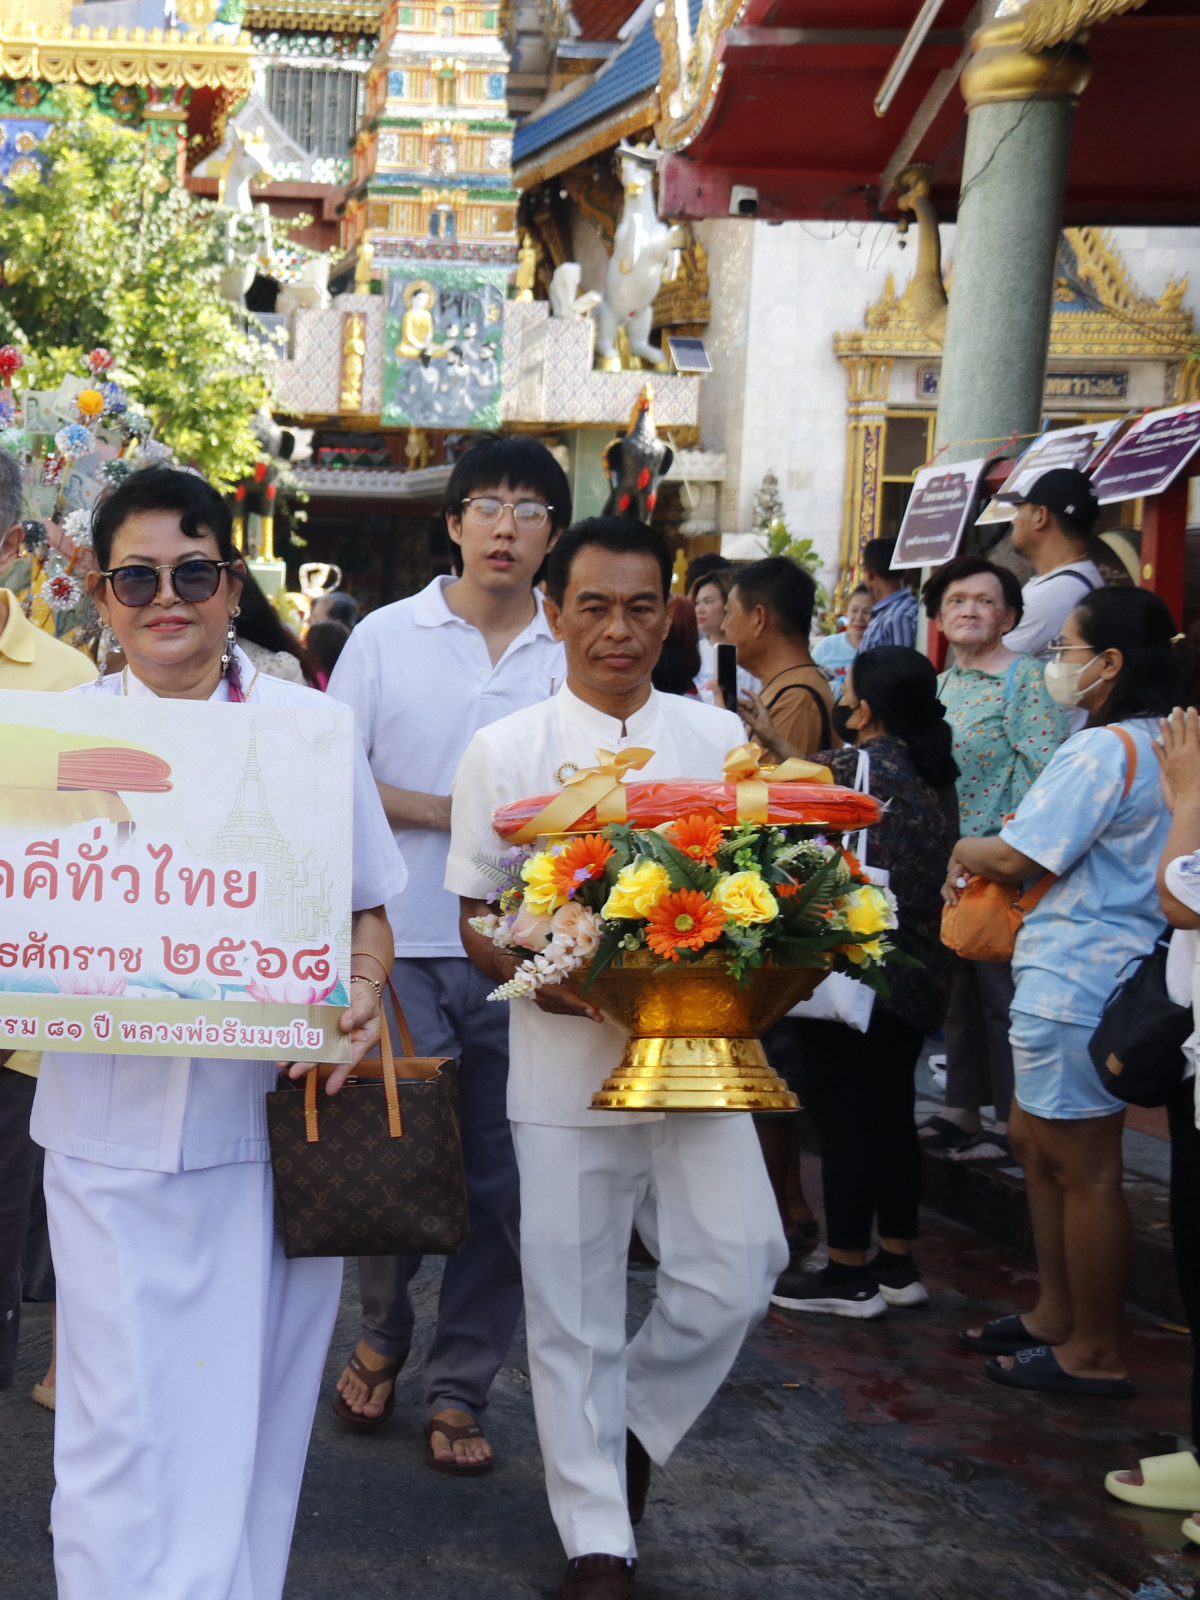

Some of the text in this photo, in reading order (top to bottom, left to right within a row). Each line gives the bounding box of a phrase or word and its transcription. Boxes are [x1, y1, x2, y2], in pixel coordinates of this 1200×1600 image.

[161, 935, 331, 982] ๒๕๖๘
[47, 1019, 83, 1041] ๘๑
[93, 1014, 111, 1039] ปี
[122, 1018, 321, 1049] หลวงพ่อธัมมชโย
